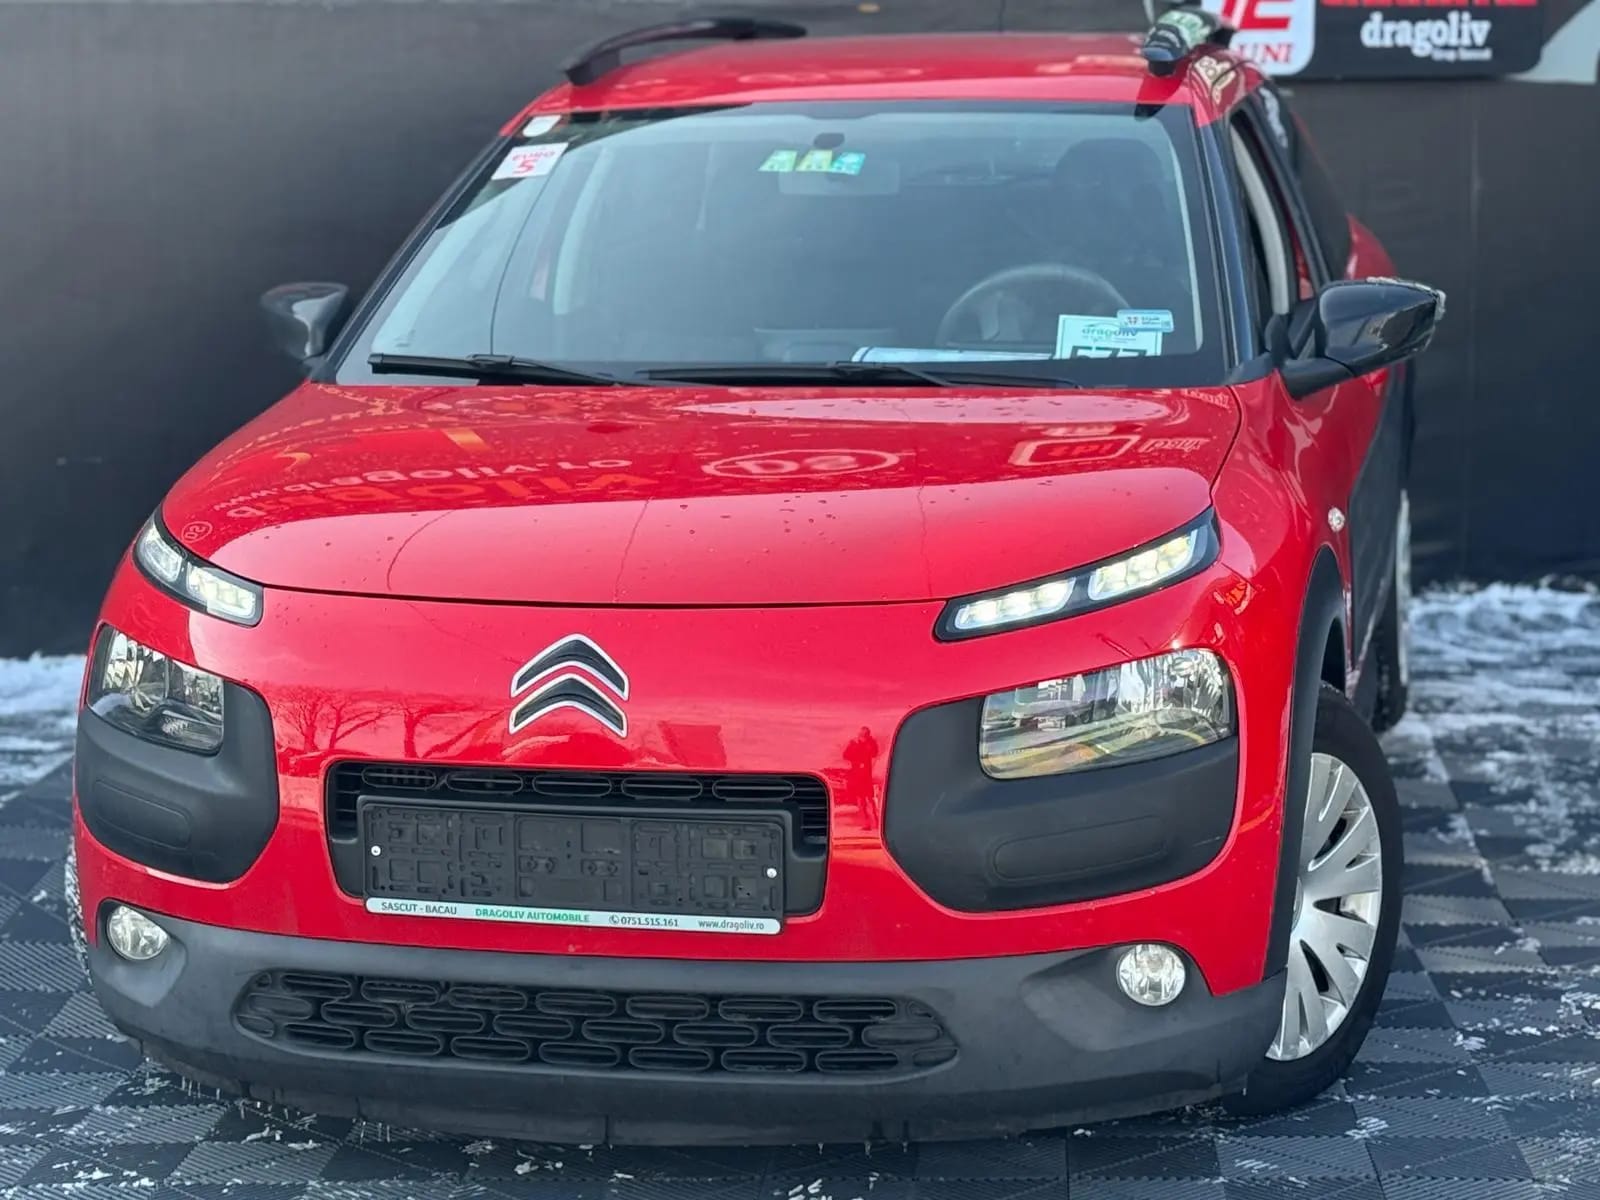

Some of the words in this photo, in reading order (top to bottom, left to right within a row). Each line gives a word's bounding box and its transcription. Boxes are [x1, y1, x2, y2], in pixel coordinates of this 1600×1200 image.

[1360, 10, 1491, 57] dragoliv
[512, 159, 534, 175] 5
[381, 901, 418, 912] SASCUT
[425, 905, 457, 915] BACAU
[475, 908, 524, 919] DRAGOLIV
[527, 911, 590, 923] AUTOMOBILE
[621, 916, 679, 928] 0751.515.161
[698, 919, 765, 931] www.dragoliv.ro
